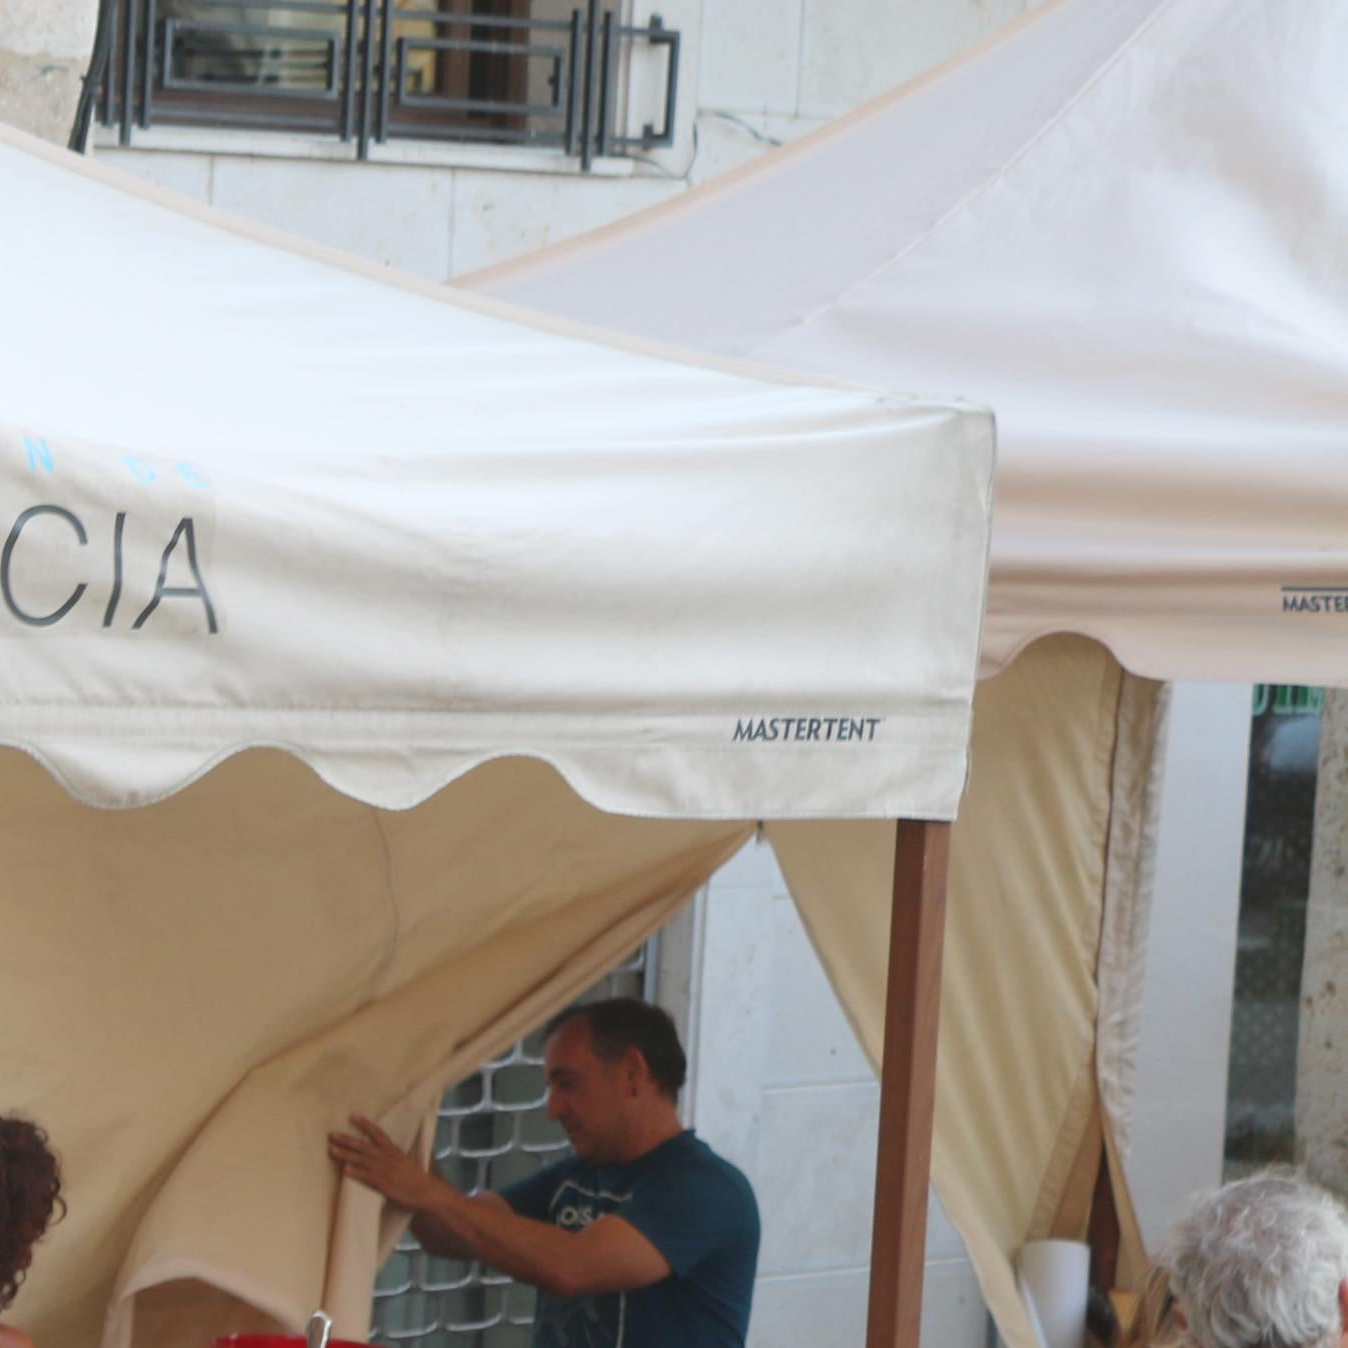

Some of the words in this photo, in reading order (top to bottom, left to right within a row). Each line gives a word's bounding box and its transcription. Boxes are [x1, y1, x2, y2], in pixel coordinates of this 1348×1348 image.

[120, 453, 216, 490] DE
[1282, 594, 1348, 613] MASTE
[732, 717, 881, 743] MASTERTENT
